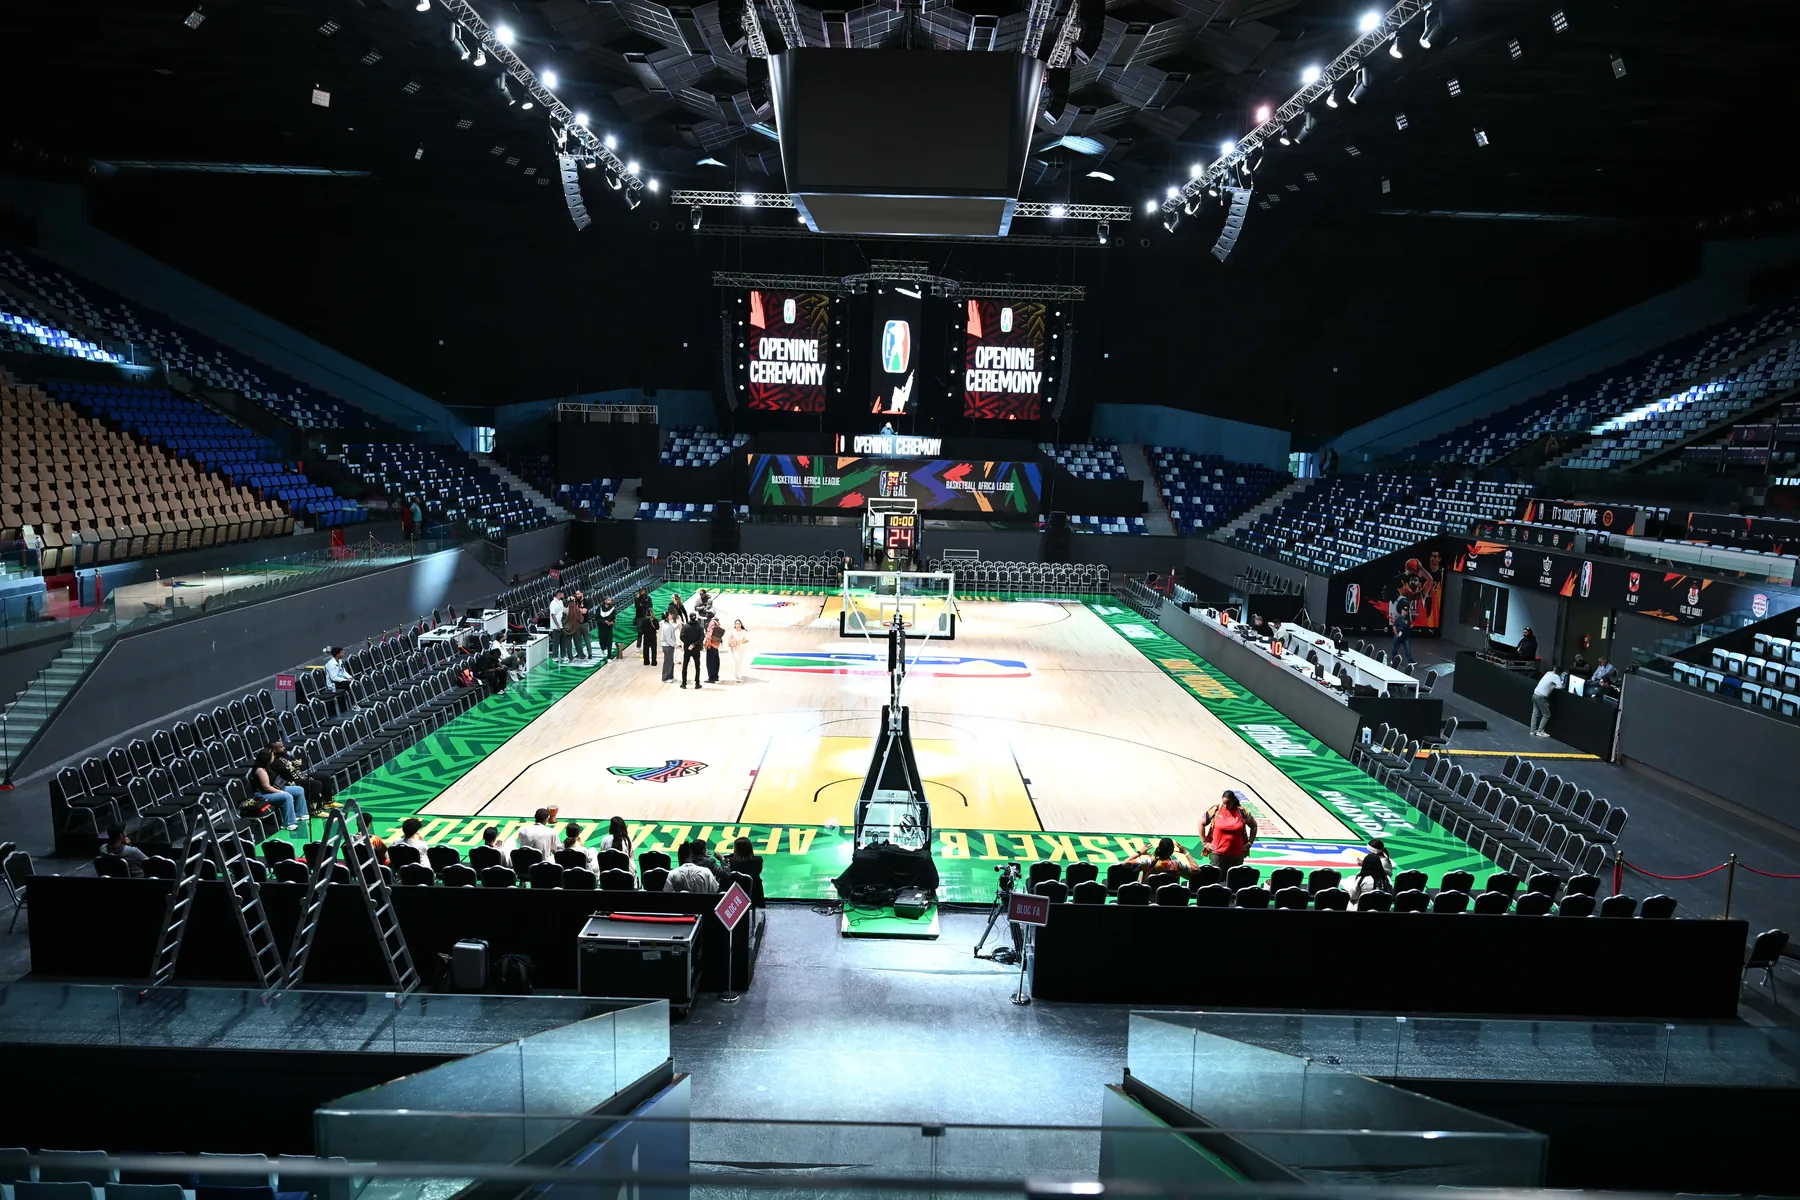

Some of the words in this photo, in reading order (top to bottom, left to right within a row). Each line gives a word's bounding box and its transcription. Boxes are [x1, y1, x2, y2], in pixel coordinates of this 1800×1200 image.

[759, 338, 818, 361] OPENING
[975, 346, 1035, 370] OPENING
[750, 361, 826, 386] CEREMONY
[966, 369, 1042, 394] CEREMONY
[853, 436, 892, 454] OPENING
[896, 438, 942, 456] CEREMONY
[772, 475, 802, 485] BASKETBALL
[804, 476, 821, 485] AFRICA
[822, 476, 840, 486] LEAGUE
[946, 480, 976, 490] BASKETBALL
[978, 481, 995, 491] AFRICA
[997, 482, 1015, 491] LEAGUE
[890, 516, 914, 527] 10:00
[1562, 509, 1583, 525] TAKEOFF
[889, 529, 911, 547] 24
[1220, 612, 1229, 625] 10
[1271, 641, 1282, 655] 10
[1317, 790, 1393, 839] RWANDA
[1362, 801, 1415, 829] VISIT
[724, 902, 738, 919] BLOC
[1016, 904, 1032, 916] BLOC
[1032, 906, 1041, 917] FA
